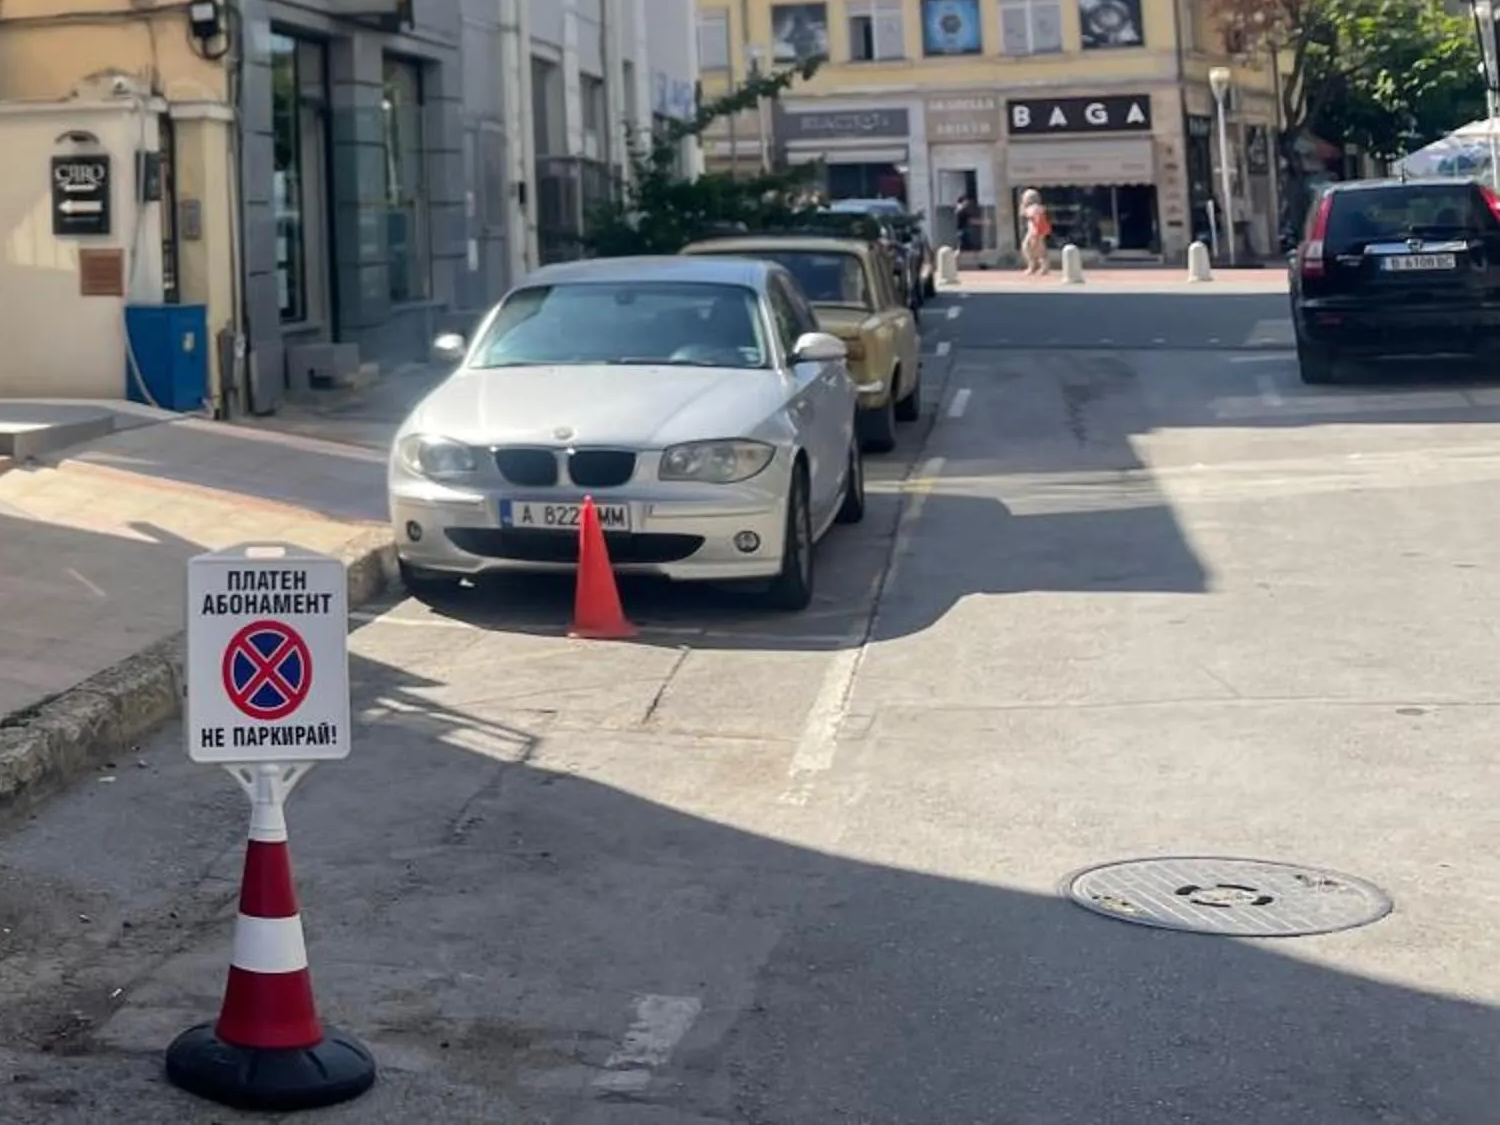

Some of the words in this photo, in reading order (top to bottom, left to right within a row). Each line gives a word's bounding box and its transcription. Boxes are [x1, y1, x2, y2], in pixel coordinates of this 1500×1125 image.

[1013, 103, 1146, 127] BAGA
[544, 505, 585, 526] 822
[227, 570, 307, 592] ПЛАТЕН
[202, 593, 333, 615] АБОНАМЕНТ
[201, 727, 225, 748] НЕ
[233, 722, 338, 747] ПАРКИРАЙ!
